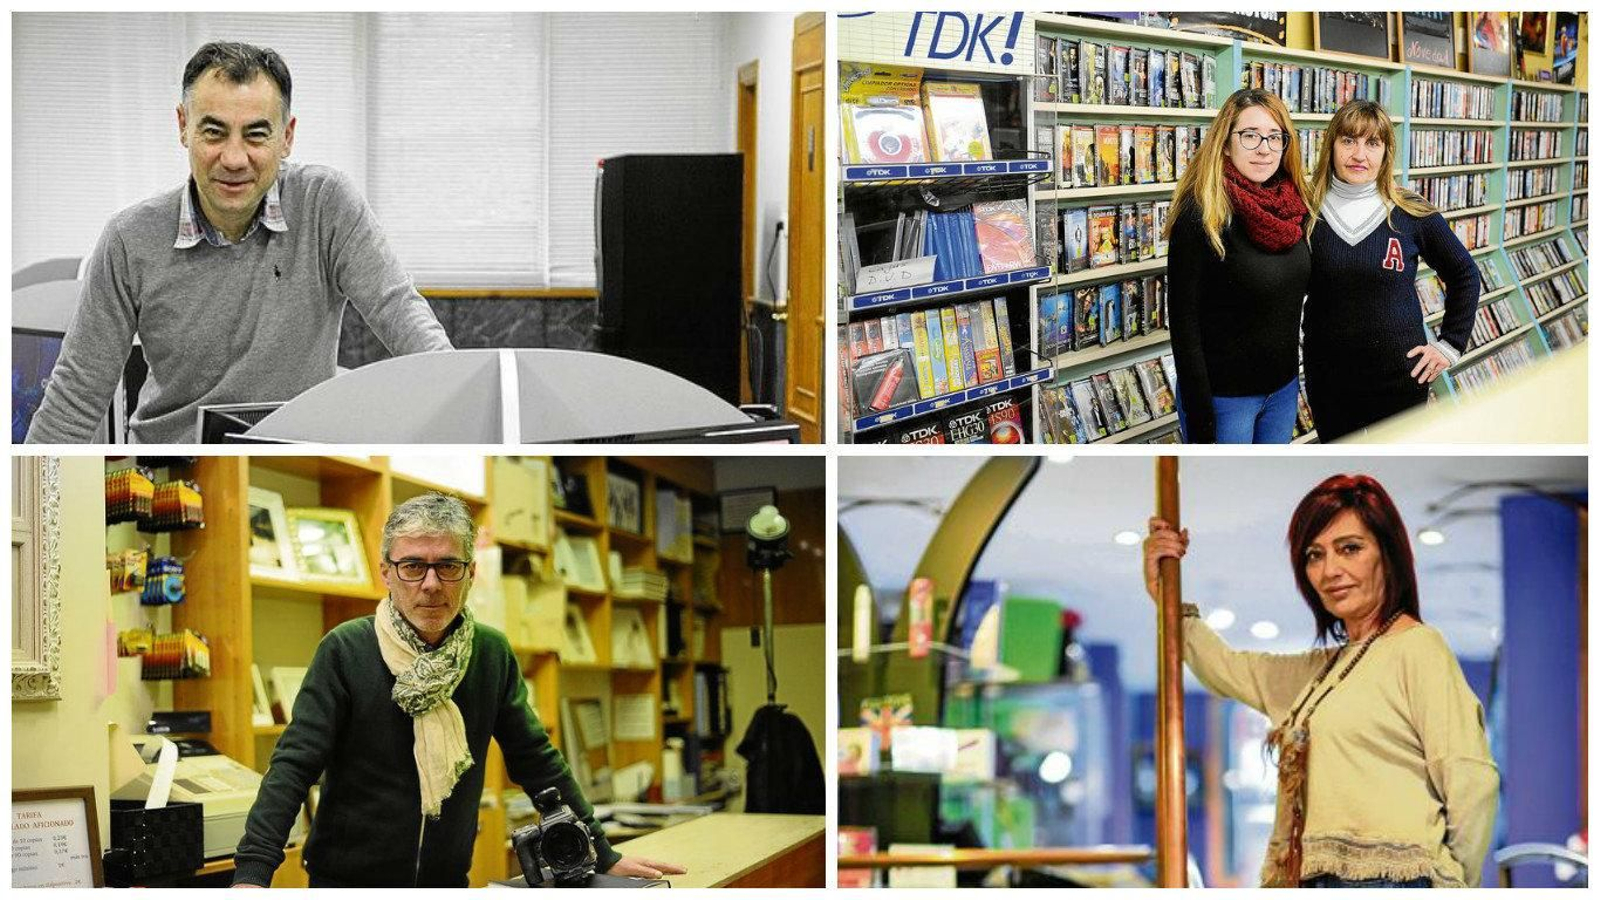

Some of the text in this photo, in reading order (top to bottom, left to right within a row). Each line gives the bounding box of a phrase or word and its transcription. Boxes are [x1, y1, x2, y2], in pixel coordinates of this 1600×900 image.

[904, 12, 1024, 65] TDK!
[1383, 237, 1405, 272] A
[991, 399, 1013, 412] TDK
[956, 412, 982, 426] TDK
[910, 425, 938, 440] TDK
[33, 819, 75, 829] AFICIONADO
